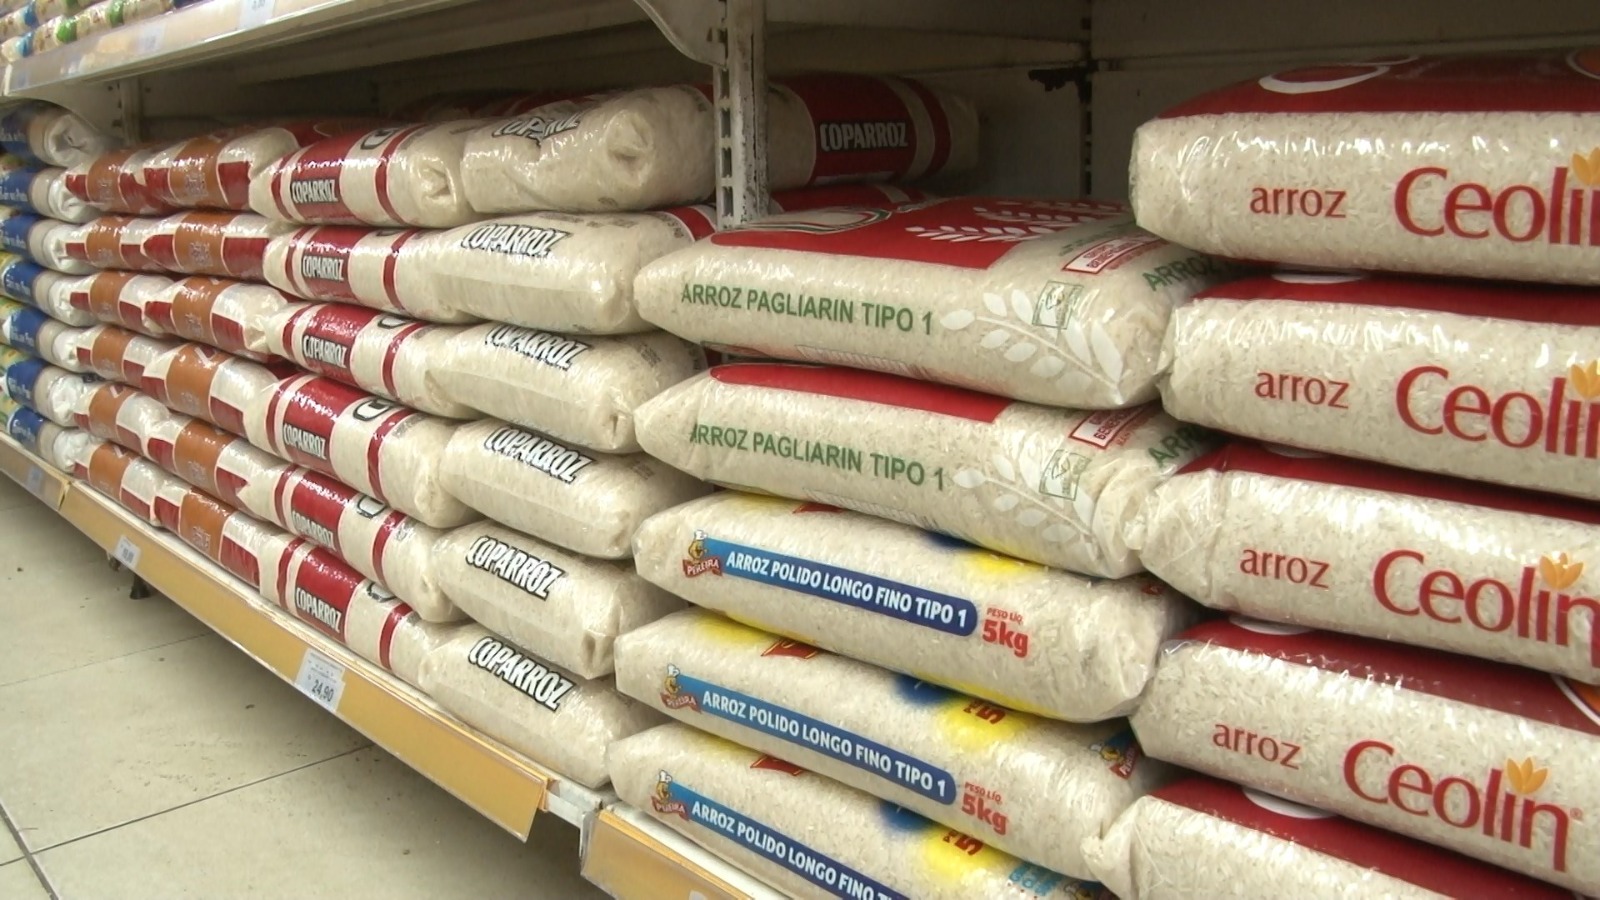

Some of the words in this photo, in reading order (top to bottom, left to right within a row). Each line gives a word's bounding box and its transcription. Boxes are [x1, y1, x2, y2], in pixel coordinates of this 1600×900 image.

[820, 121, 908, 152] COPARROZ
[291, 179, 339, 203] COPARROZ
[1249, 186, 1347, 219] arroz
[460, 224, 571, 258] COPARROZ
[302, 255, 345, 281] COPARROZ
[681, 283, 741, 309] ARROZ
[747, 289, 853, 324] PAGLIARIN
[862, 302, 913, 333] TIPO
[922, 311, 932, 335] 1
[302, 334, 348, 368] COPARROZ
[485, 325, 593, 371] COPARROZ
[1255, 371, 1349, 408] arroz
[282, 423, 327, 460] COPARROZ
[484, 426, 597, 484] COPARROZ
[754, 432, 861, 473] PAGLIARIN
[870, 453, 924, 487] TIPO
[934, 467, 943, 491] 1
[291, 510, 336, 550] COPARROZ
[466, 535, 566, 601] COPARROZ
[726, 551, 768, 575] ARROZ
[771, 561, 821, 588] POLIDO
[823, 572, 873, 601] LONGO
[875, 586, 911, 612] FINO
[915, 597, 953, 623] TIPO
[958, 609, 967, 628] 1
[295, 586, 342, 633] COPARROZ
[987, 607, 1008, 619] PESO
[1240, 548, 1330, 588] arroz
[1373, 549, 1600, 668] Ceolin
[982, 619, 1028, 658] 5kg
[468, 636, 576, 711] COPARROZ
[703, 690, 746, 719] ARROZ
[750, 706, 799, 737] POLIDO
[803, 724, 851, 757] LONGO
[856, 744, 891, 773] FINO
[895, 761, 933, 791] TIPO
[938, 779, 946, 797] 1
[965, 782, 985, 797] PESO
[1212, 723, 1301, 770] arroz
[1343, 740, 1569, 872] Ceolin
[961, 793, 1008, 836] 5kg
[692, 801, 735, 833] ARROZ
[737, 822, 786, 860] POLIDO
[788, 846, 836, 886] LONGO
[839, 872, 874, 900] FINO
